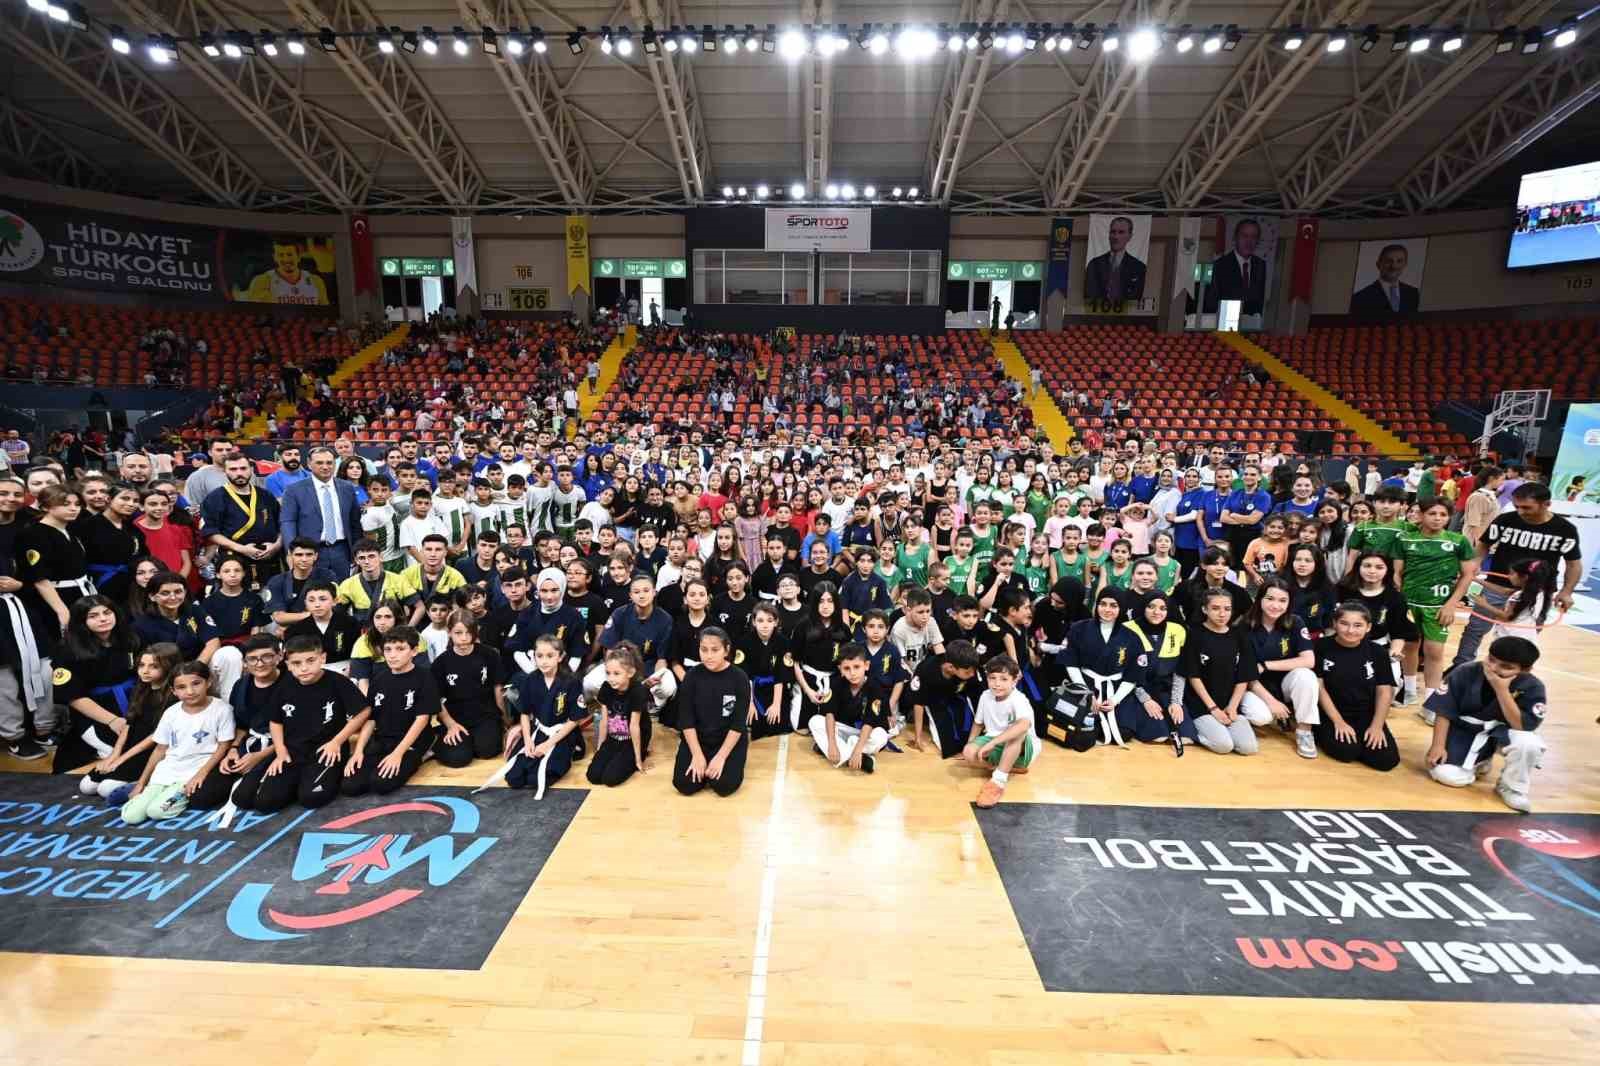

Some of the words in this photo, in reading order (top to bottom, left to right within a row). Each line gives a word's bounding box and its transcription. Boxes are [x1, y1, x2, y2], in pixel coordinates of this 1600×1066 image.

[67, 222, 192, 255] HİDAYET
[786, 215, 849, 228] SPORTOTO
[48, 243, 211, 279] TÜRKOĞLU
[52, 266, 115, 282] SPOR
[127, 274, 213, 292] SALONU
[513, 295, 546, 309] 106
[1430, 583, 1450, 598] 10
[1282, 810, 1415, 845] LİGİ
[0, 831, 236, 865] INTERNA
[1064, 836, 1471, 878] BASKETBOL
[1204, 877, 1535, 927] TÜRKİYE
[1236, 937, 1600, 985] misli.com
